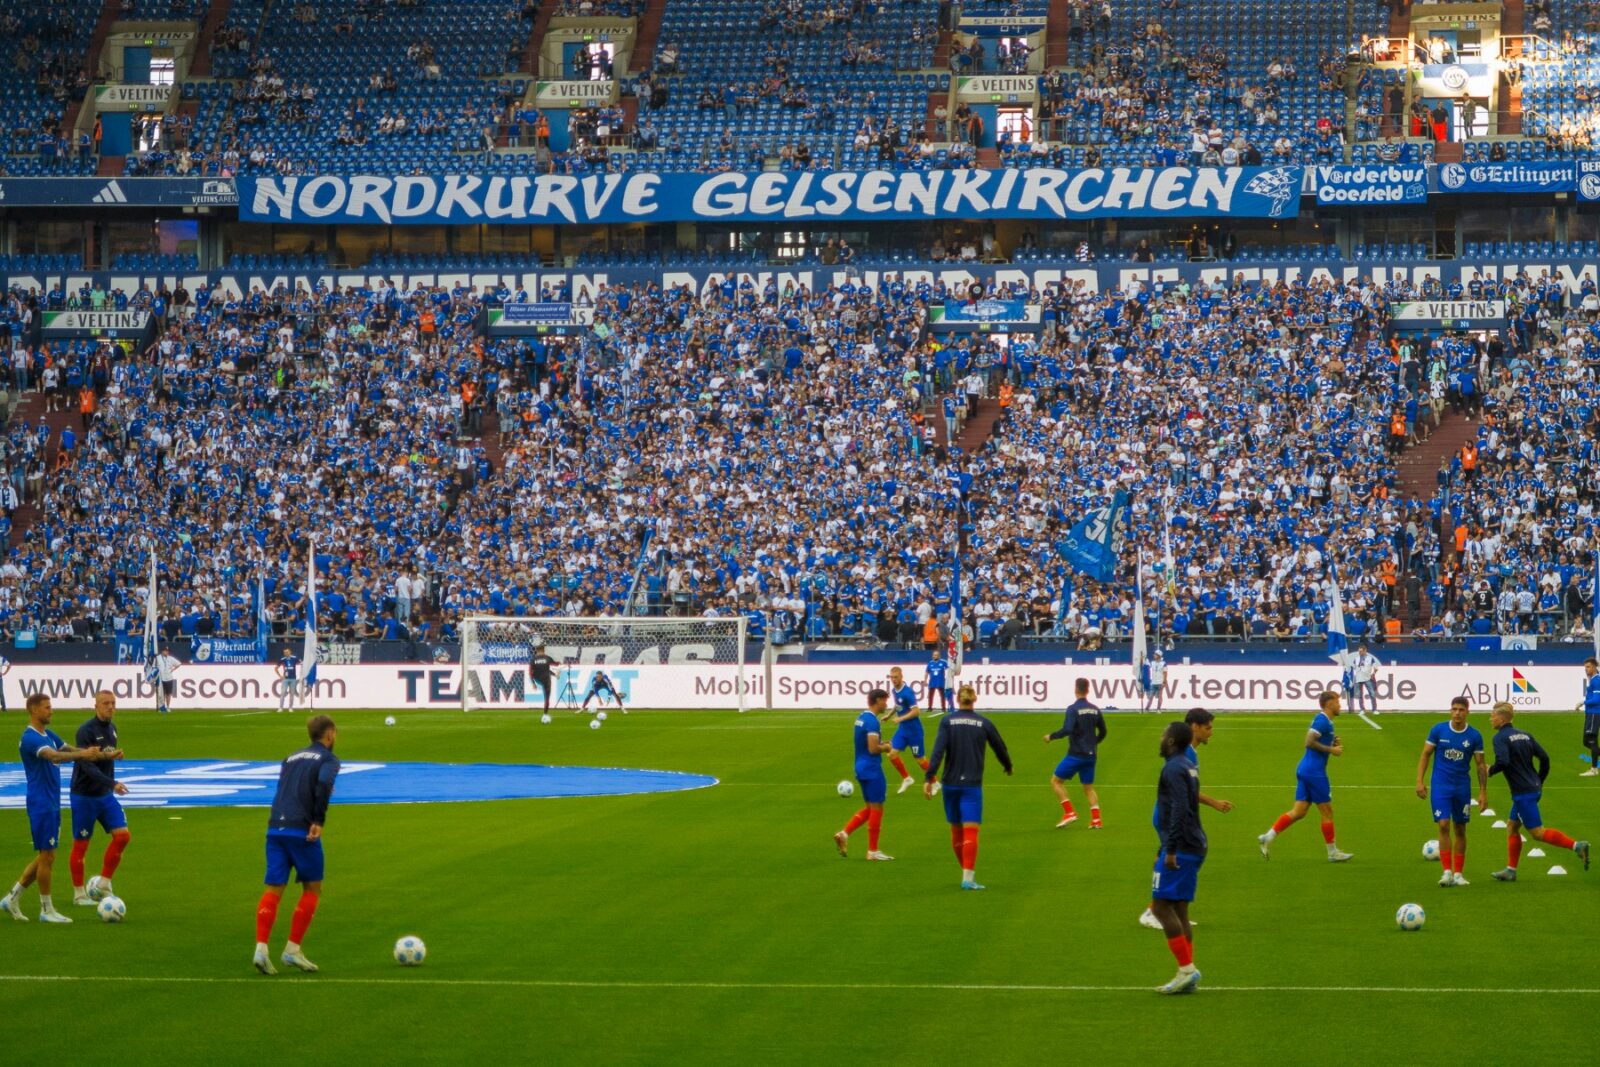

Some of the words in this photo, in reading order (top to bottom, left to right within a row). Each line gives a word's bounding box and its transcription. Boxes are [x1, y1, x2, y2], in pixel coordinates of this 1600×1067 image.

[560, 84, 611, 97] VELTINS
[982, 79, 1035, 92] VELTINS
[119, 88, 170, 100] VELTINS
[1319, 165, 1424, 184] Vorderbus
[1469, 165, 1573, 186] GErlingen
[252, 173, 661, 225] NORDKURVE
[692, 166, 1244, 218] GELSENKIRCHEN
[1319, 184, 1403, 202] Coesfeld
[1428, 303, 1496, 318] VELTINS
[77, 313, 140, 328] VELTINS
[213, 652, 256, 664] Knappen
[695, 675, 764, 696] Mobil
[778, 674, 925, 702] Sponsorig
[944, 673, 1049, 703] ffällig
[1091, 673, 1417, 701] www.teamsea.de
